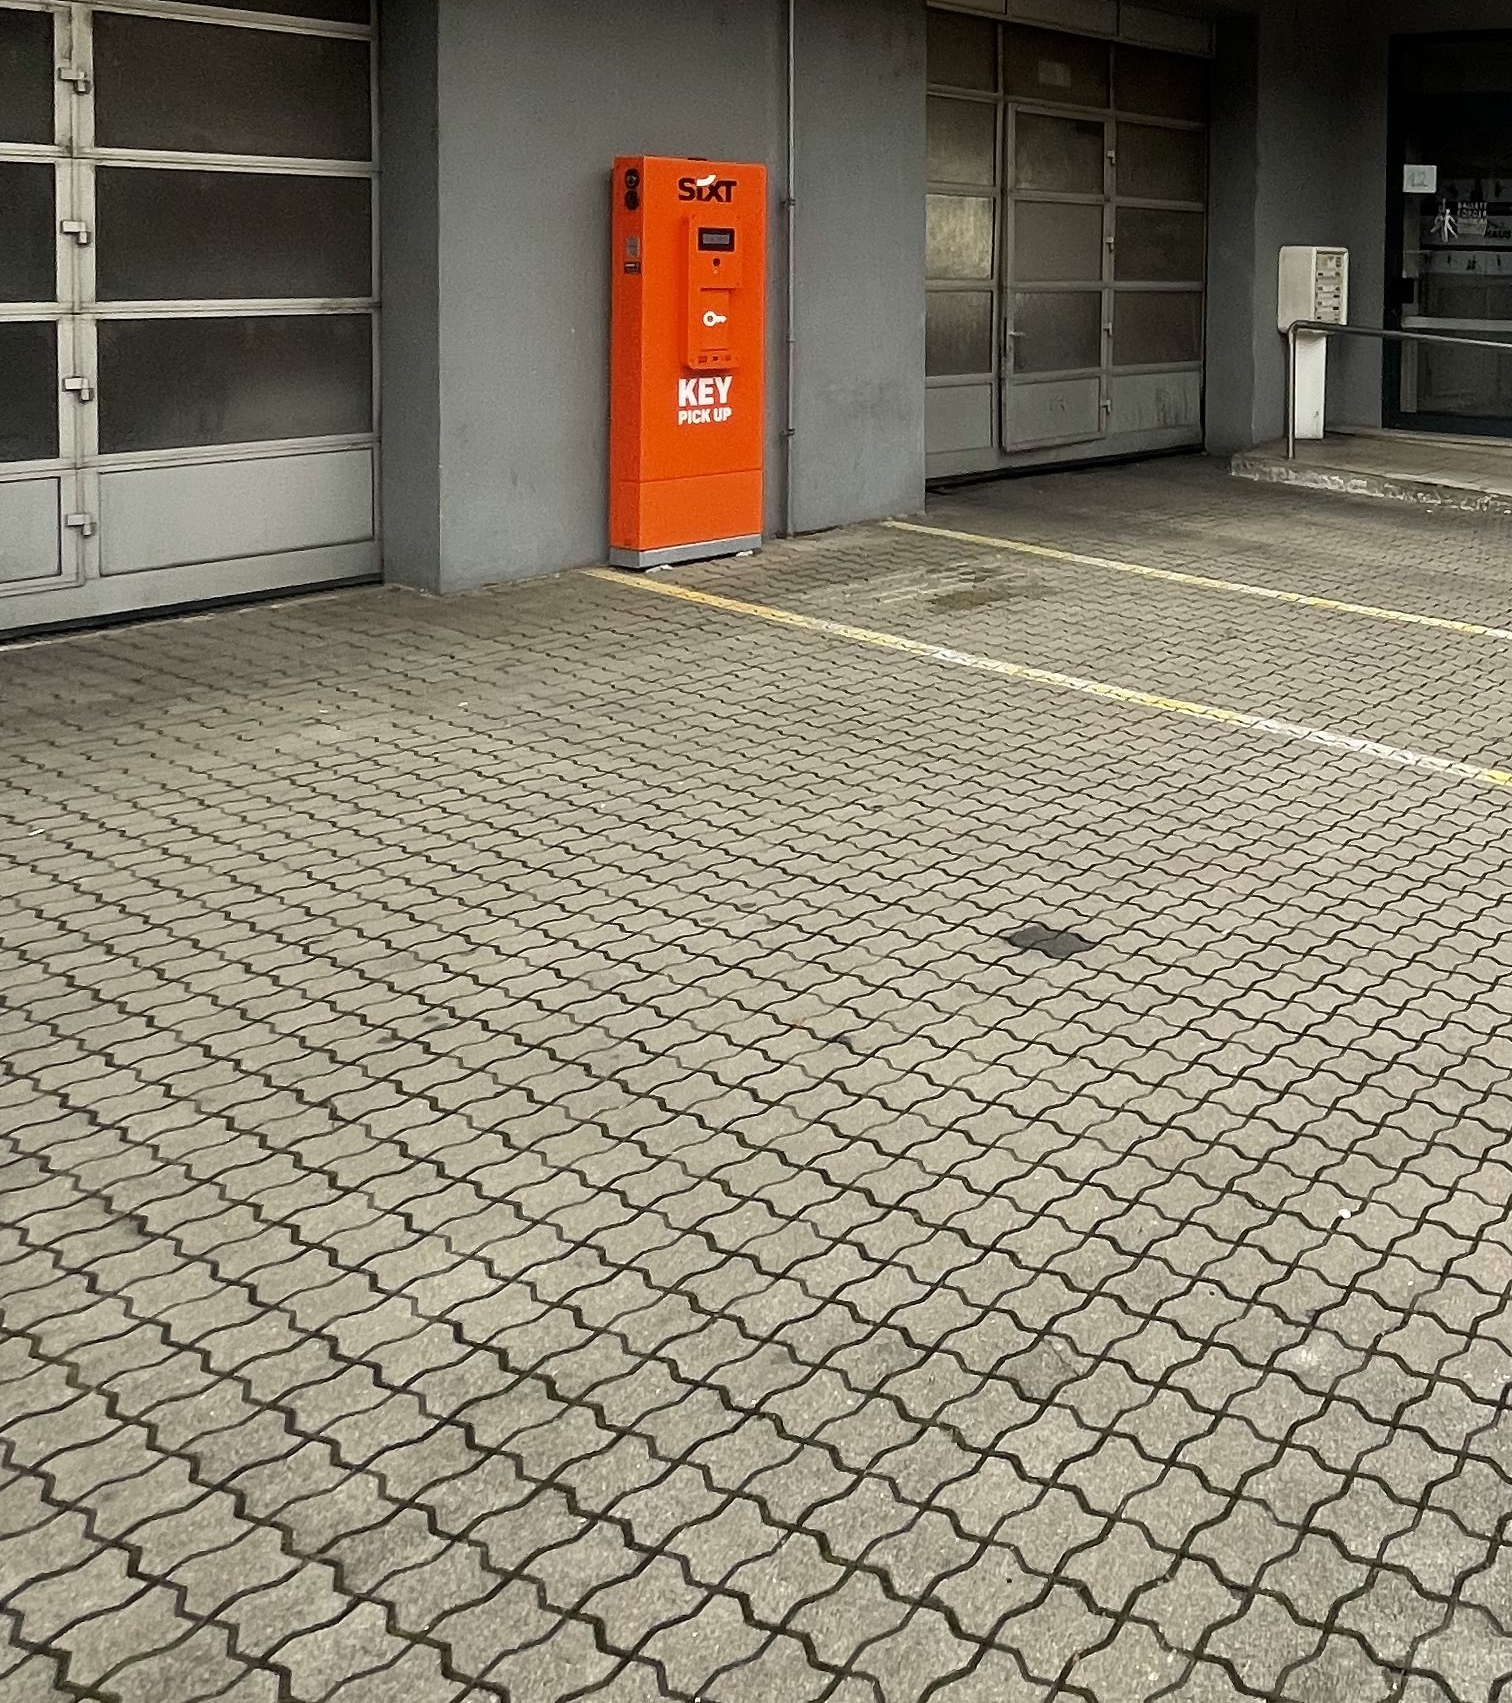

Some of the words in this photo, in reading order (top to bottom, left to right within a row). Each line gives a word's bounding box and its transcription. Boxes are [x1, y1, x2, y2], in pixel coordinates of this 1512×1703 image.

[678, 376, 733, 407] KEY
[678, 408, 712, 426] PICK
[713, 406, 733, 422] UP
